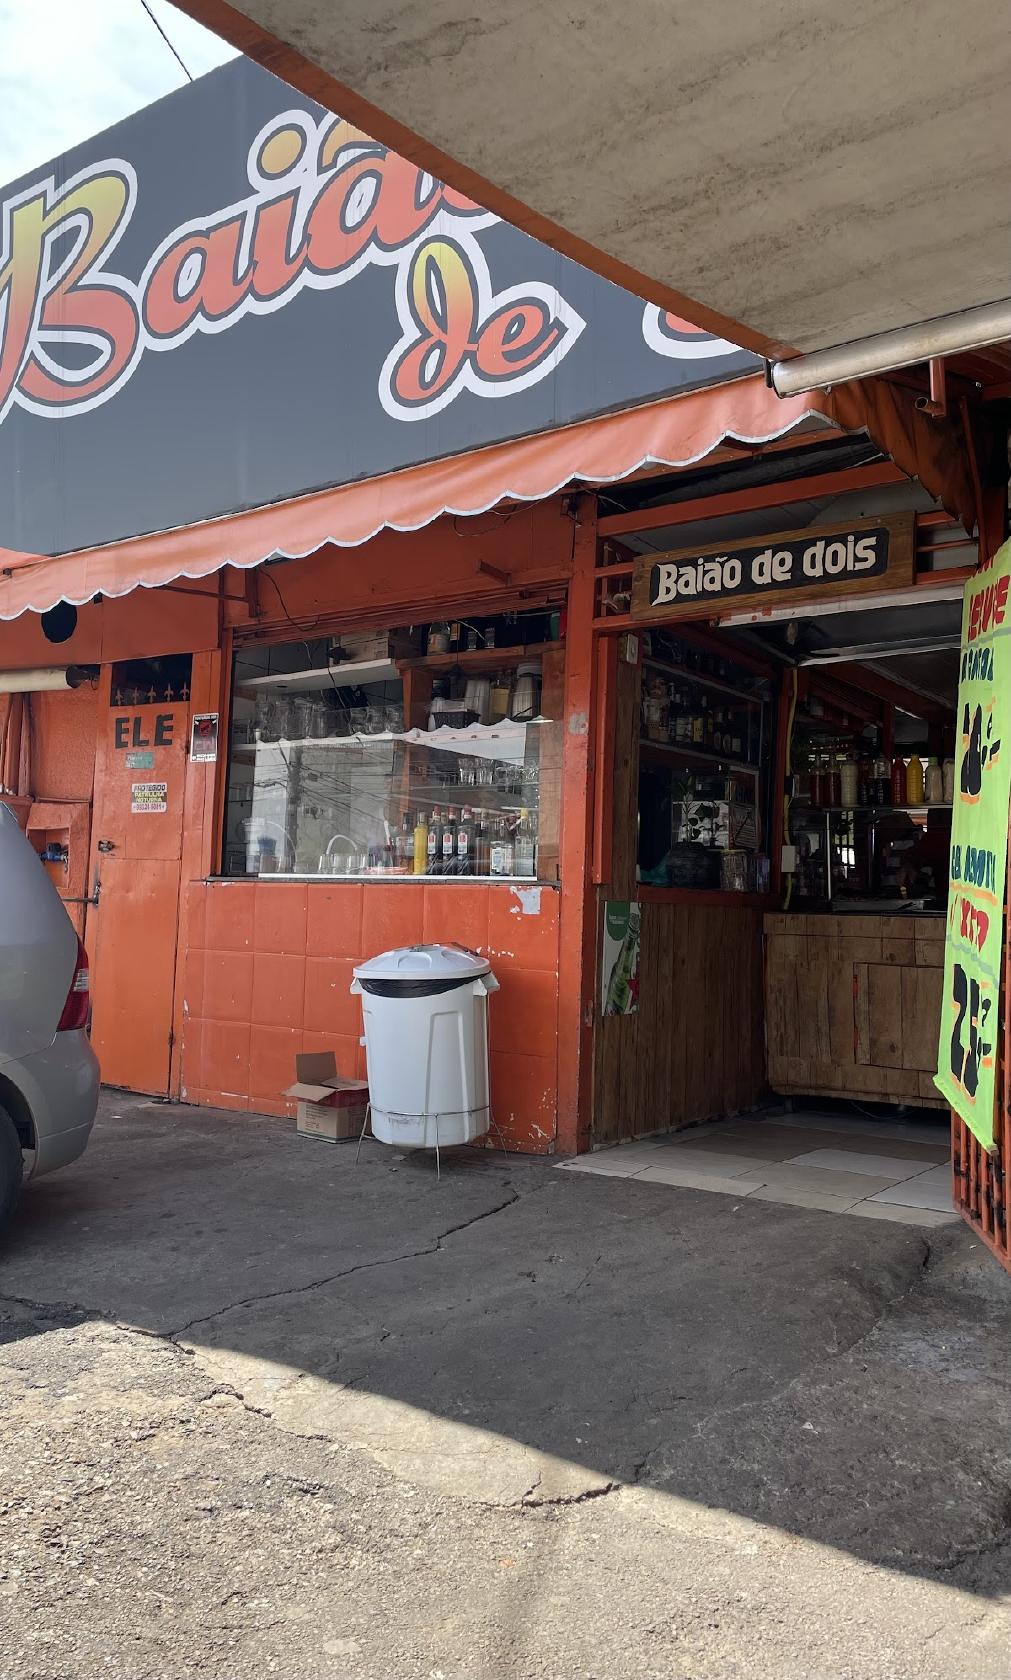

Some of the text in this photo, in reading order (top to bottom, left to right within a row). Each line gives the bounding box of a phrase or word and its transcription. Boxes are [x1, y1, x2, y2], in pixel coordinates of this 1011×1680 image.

[386, 238, 576, 414] de
[651, 535, 877, 607] Baião de dois
[115, 714, 174, 749] ELE
